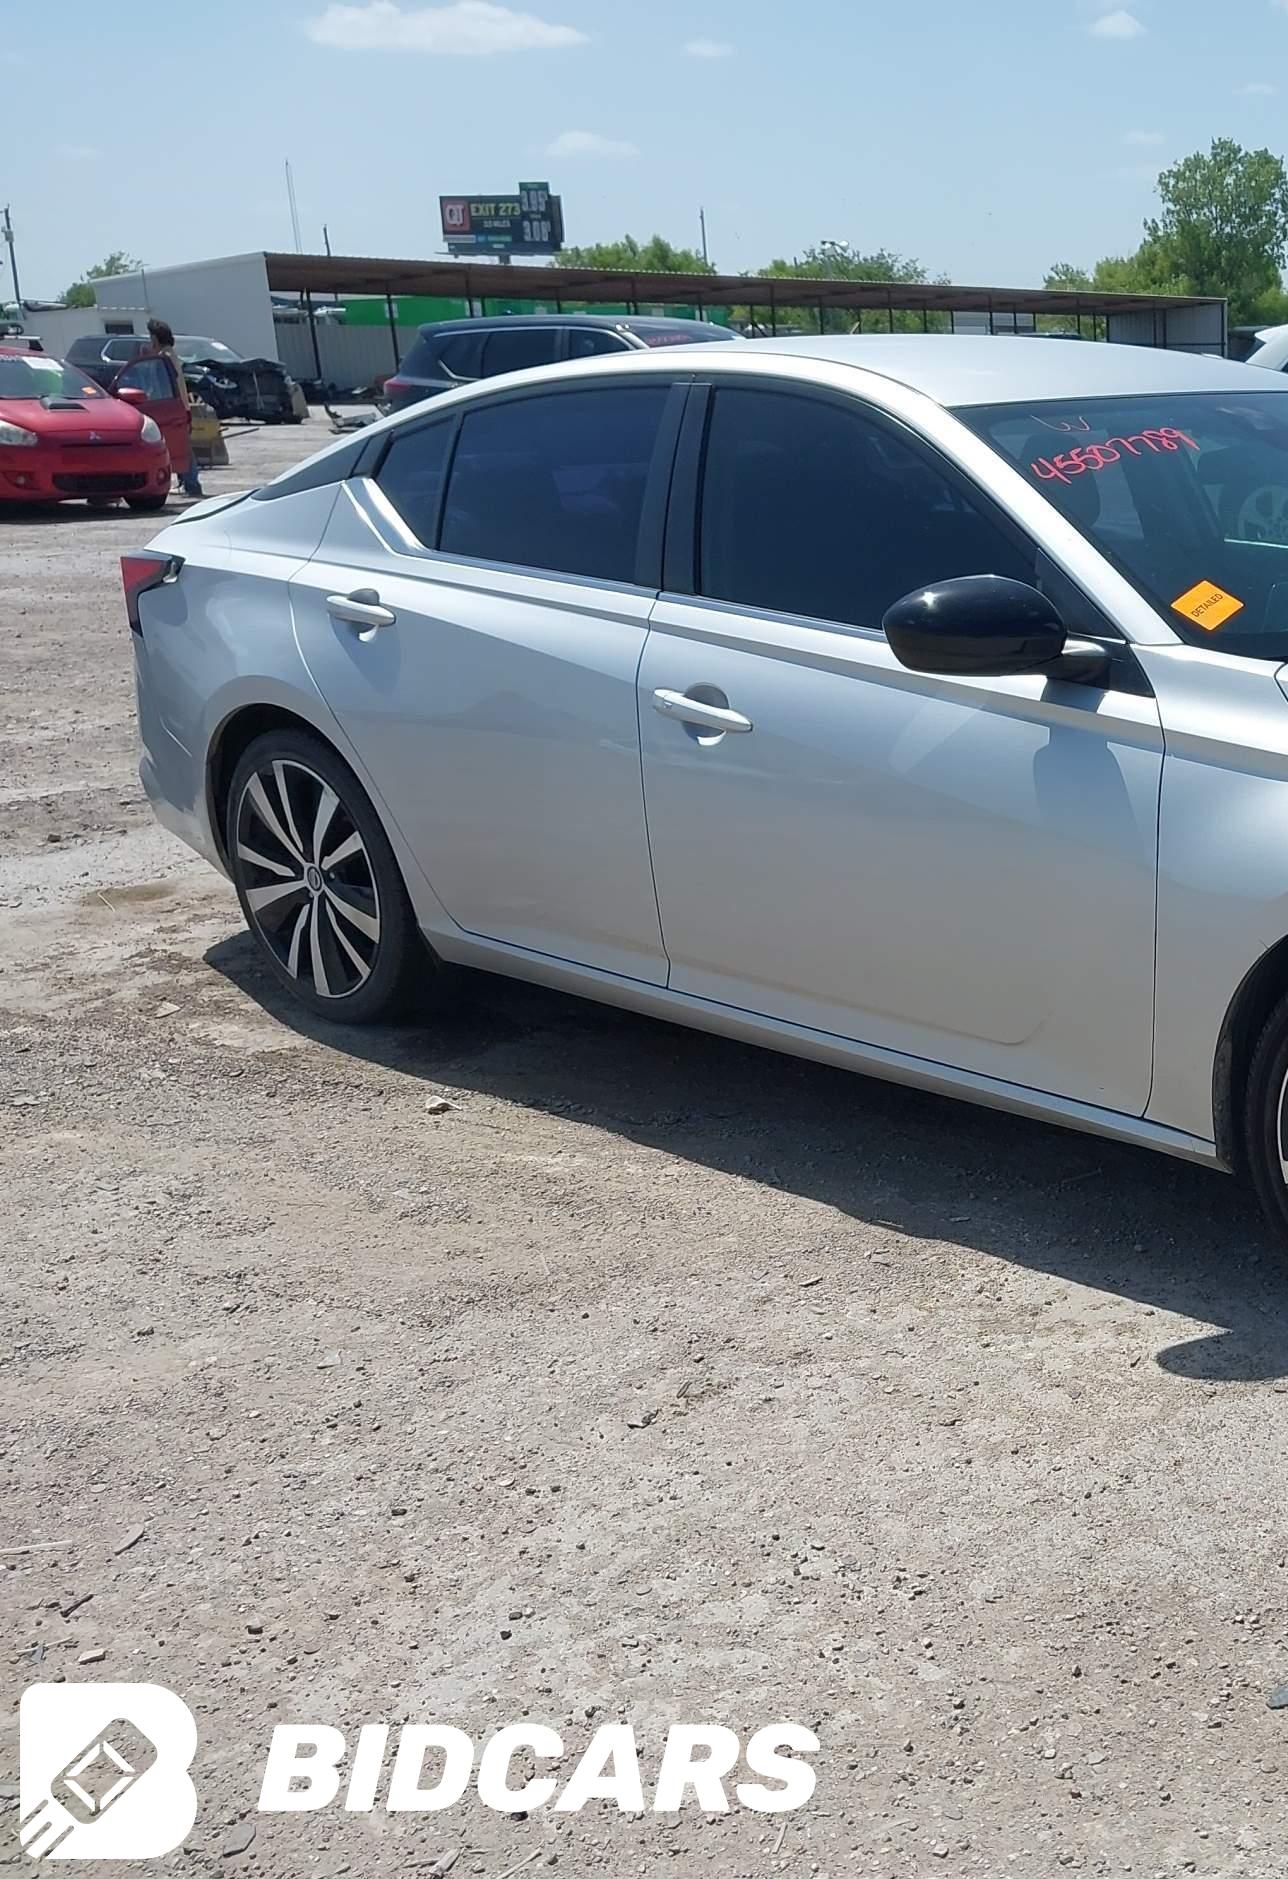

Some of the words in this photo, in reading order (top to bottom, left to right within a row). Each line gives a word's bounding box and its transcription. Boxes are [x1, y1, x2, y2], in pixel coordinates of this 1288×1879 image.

[470, 203, 495, 217] EXIT
[499, 203, 521, 216] 273
[1030, 427, 1200, 485] 45507789
[1190, 593, 1223, 618] DETAILED
